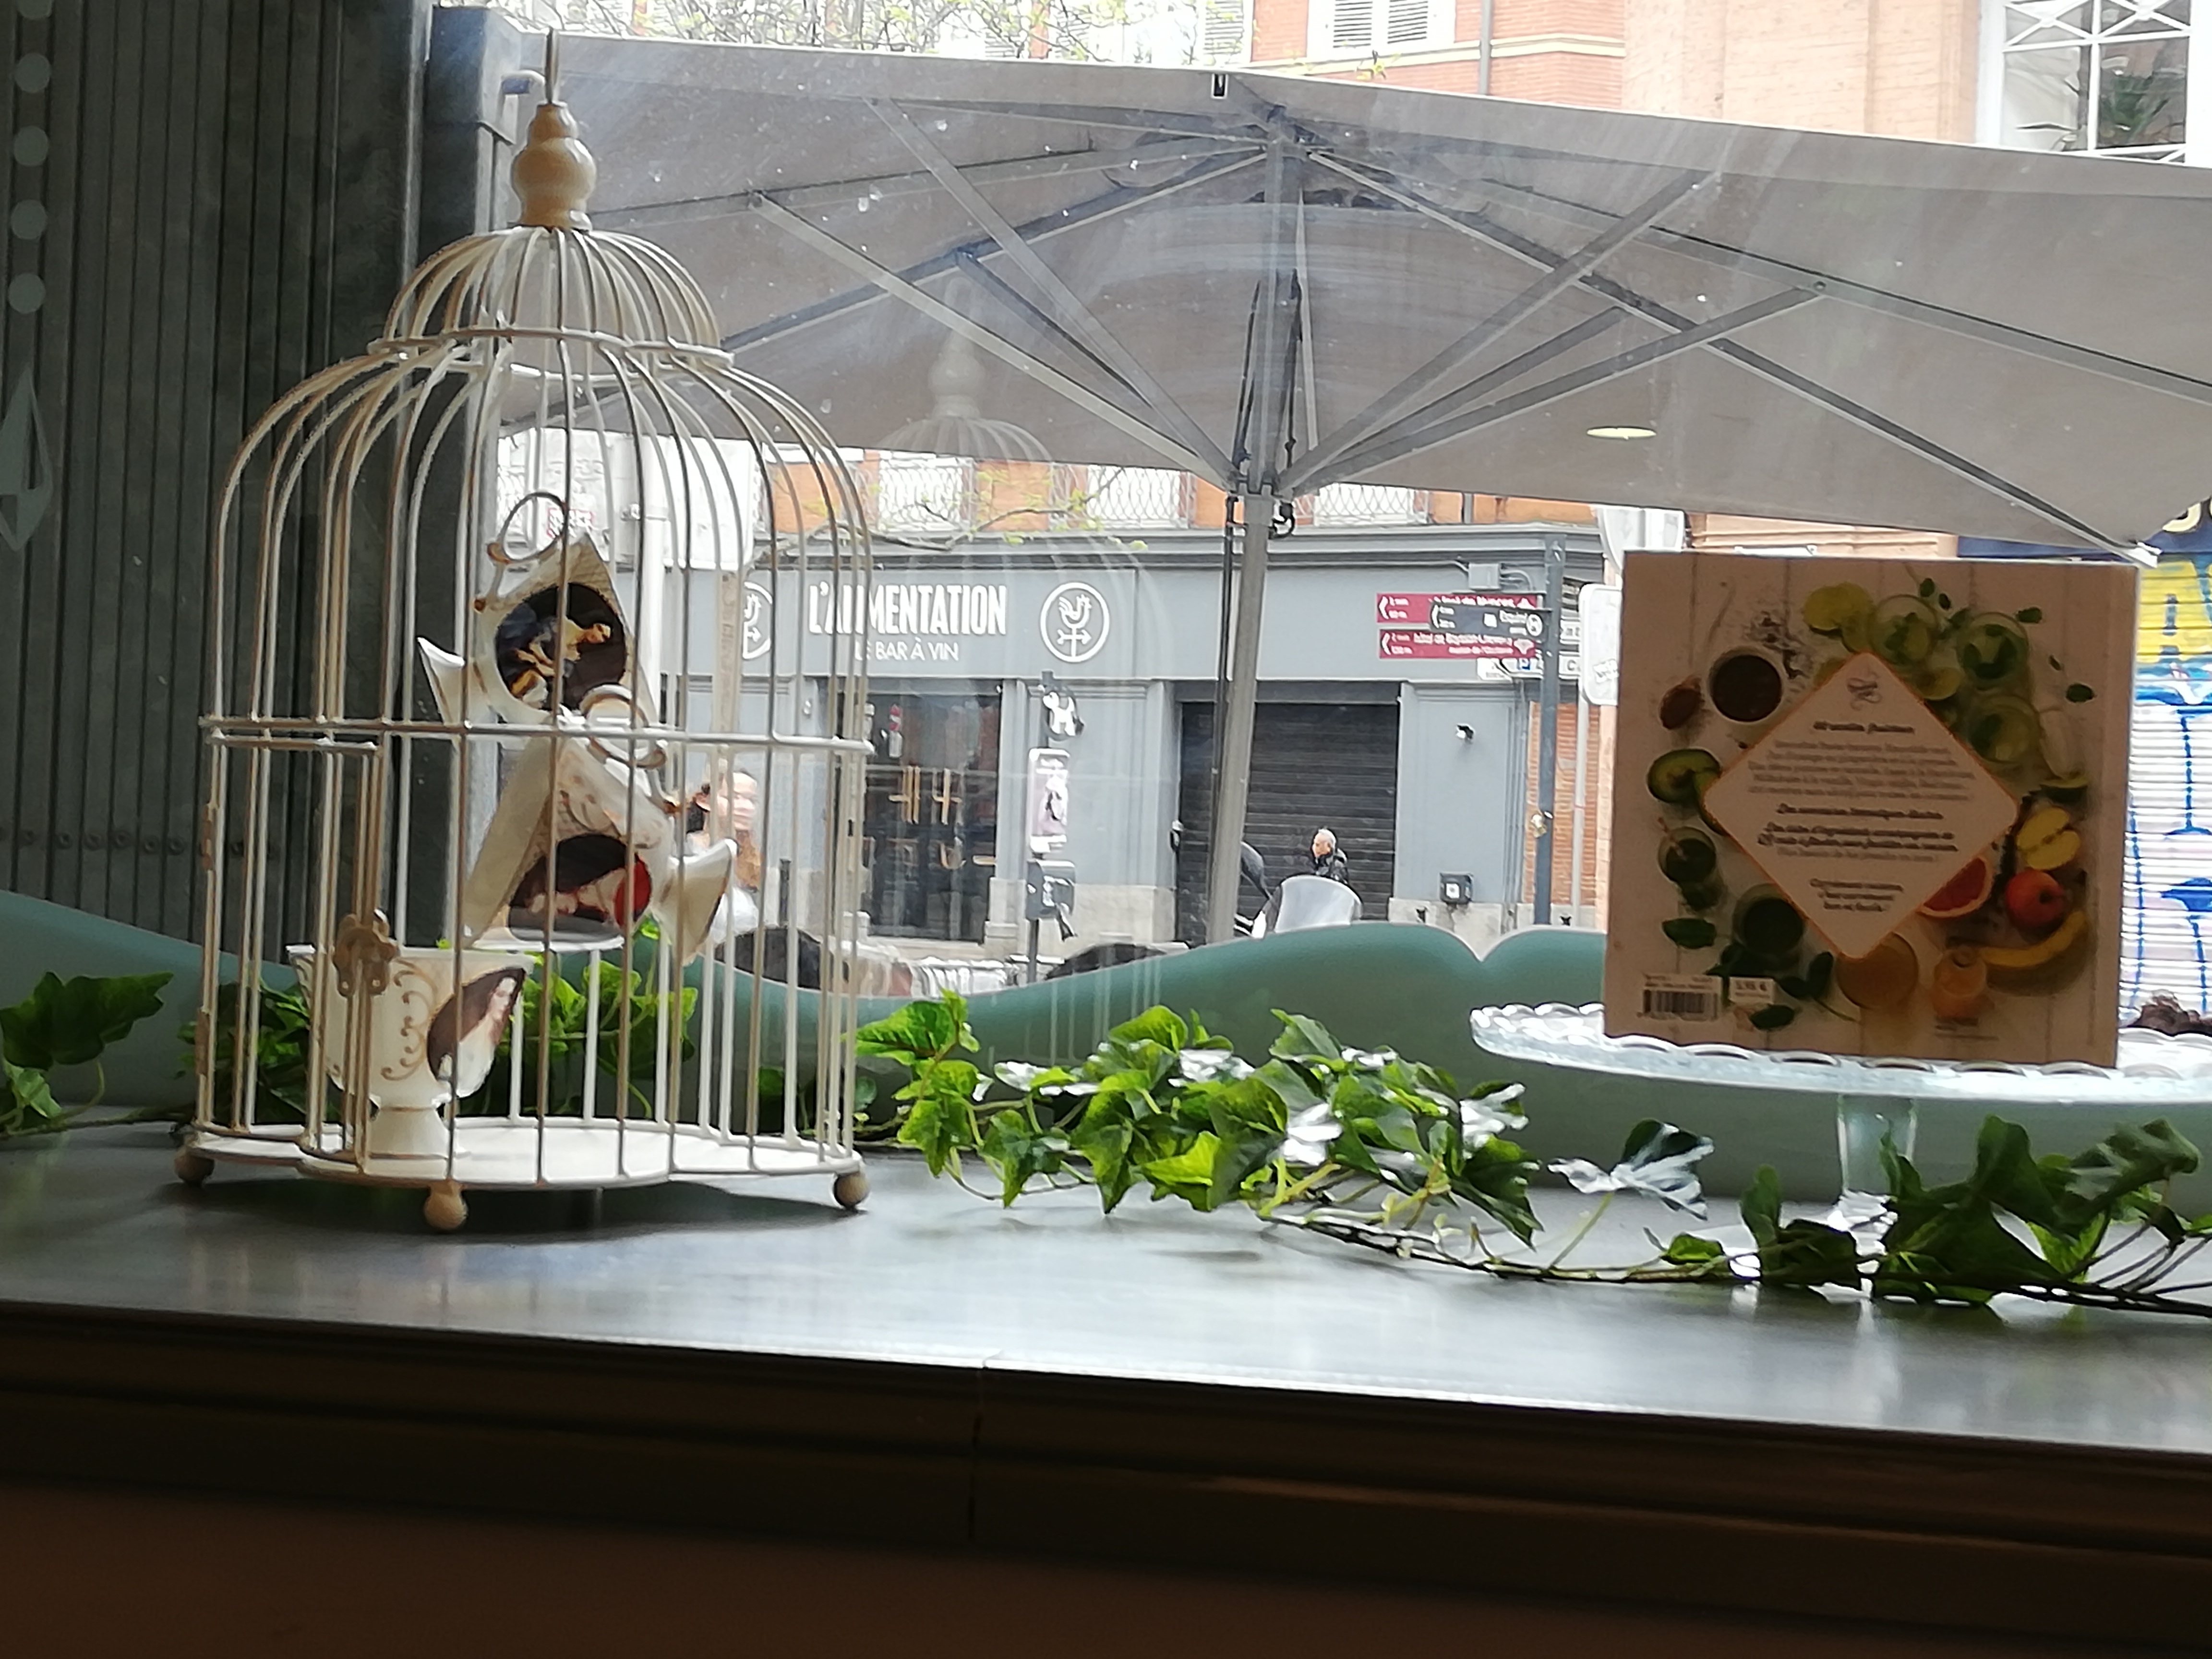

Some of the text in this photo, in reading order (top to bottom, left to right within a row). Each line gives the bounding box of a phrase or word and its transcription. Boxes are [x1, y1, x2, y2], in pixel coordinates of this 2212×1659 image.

[876, 641, 908, 661] BAR
[910, 637, 926, 661] À
[927, 642, 959, 661] VIN
